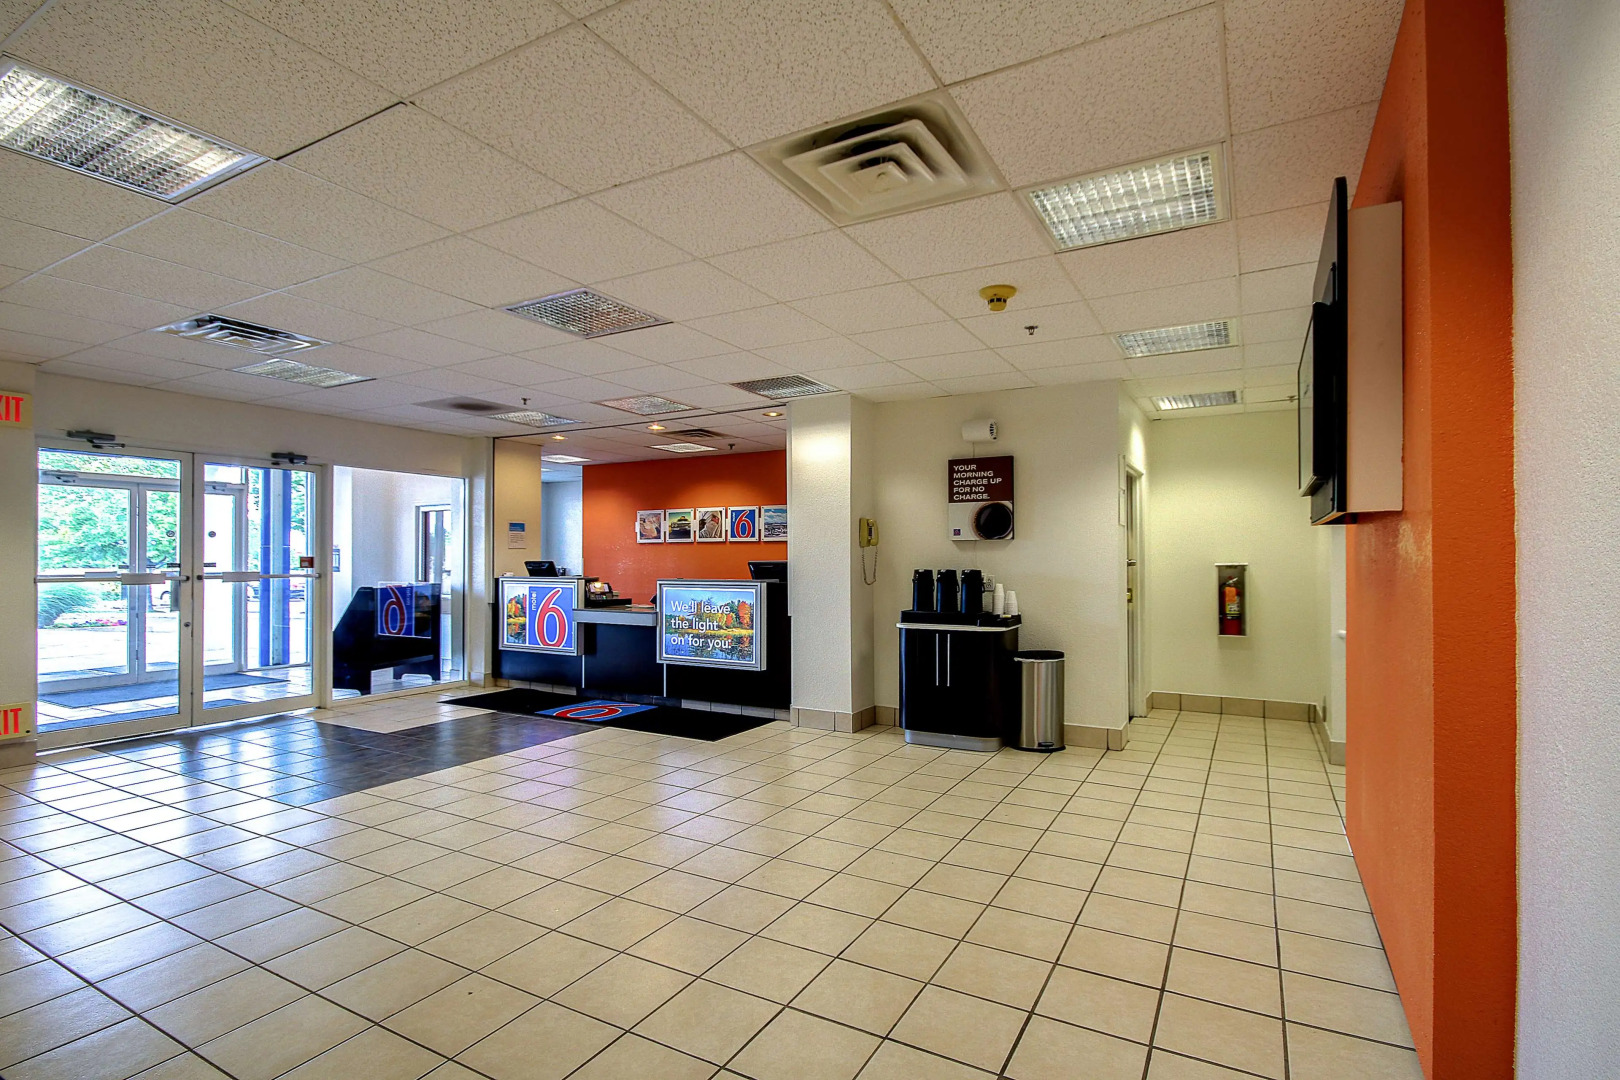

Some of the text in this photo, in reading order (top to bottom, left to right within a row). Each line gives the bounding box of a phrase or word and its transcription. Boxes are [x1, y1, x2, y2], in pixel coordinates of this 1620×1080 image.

[0, 394, 24, 423] IT
[953, 471, 994, 479] MORNING
[734, 510, 753, 539] 6
[535, 587, 568, 648] 6
[701, 600, 731, 614] leave
[671, 617, 719, 633] the light
[671, 636, 684, 645] on
[688, 634, 704, 646] for
[0, 707, 22, 736] IT
